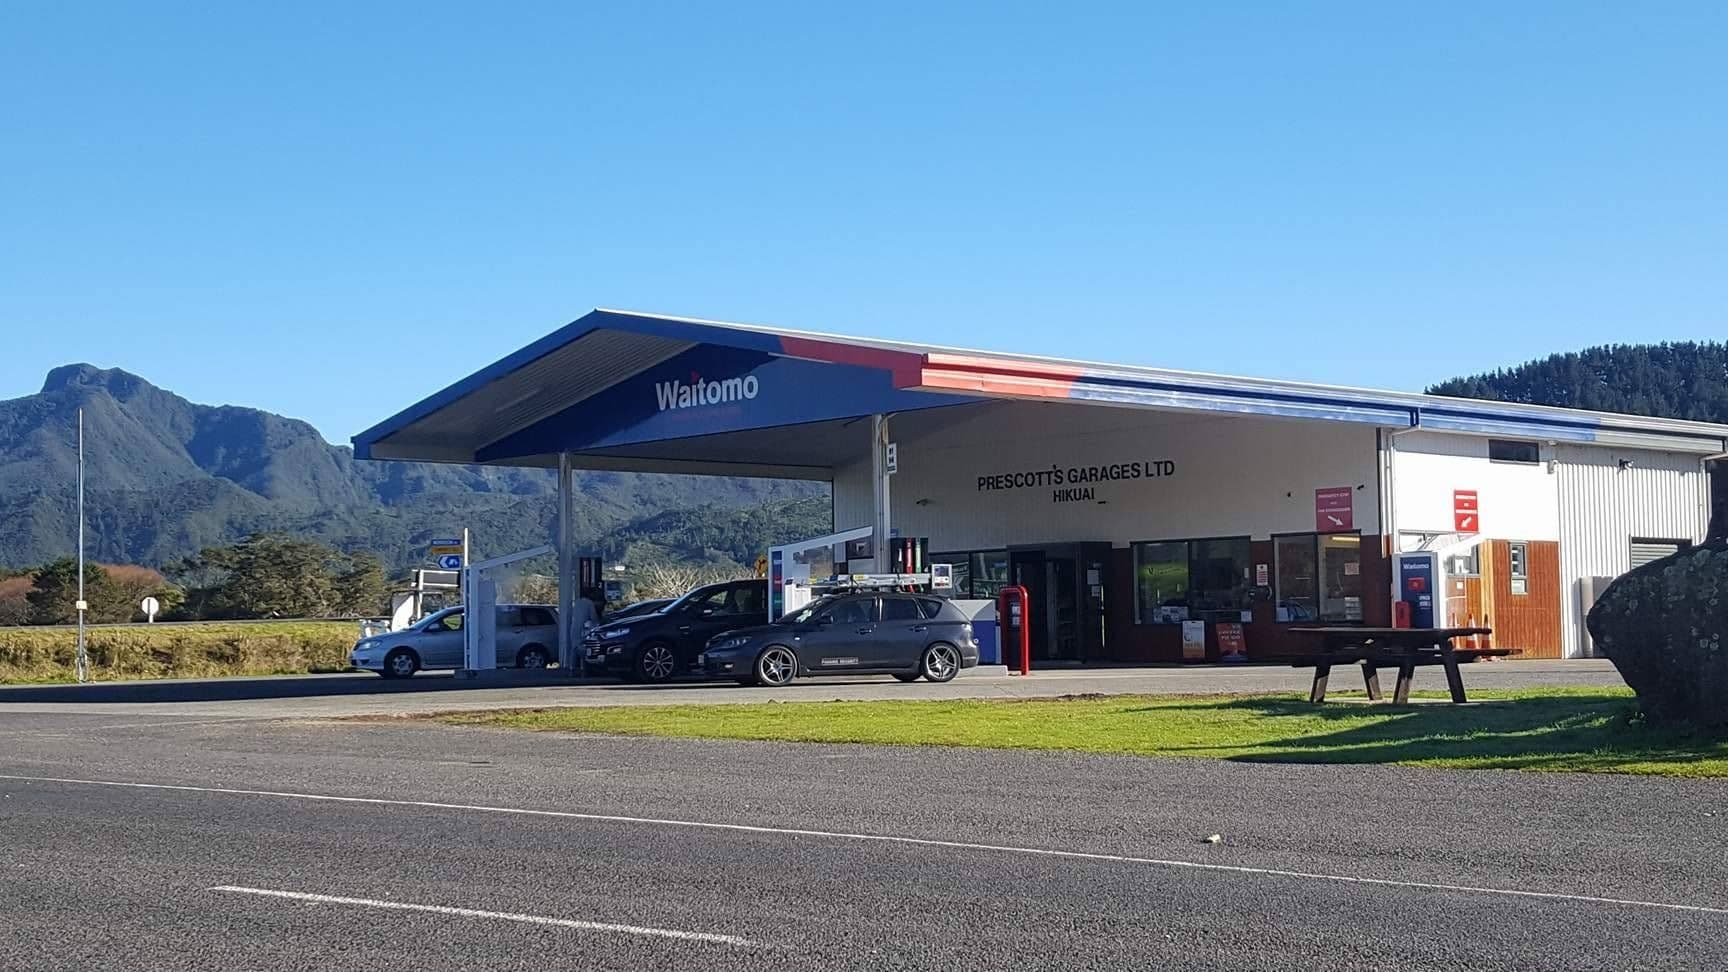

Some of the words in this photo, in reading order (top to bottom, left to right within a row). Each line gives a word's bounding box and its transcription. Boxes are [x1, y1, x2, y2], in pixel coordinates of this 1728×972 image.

[655, 372, 759, 411] Waitomo
[978, 464, 1064, 491] PRESCOTT'S
[1068, 462, 1141, 483] GARAGES
[1145, 460, 1175, 478] LTD
[1053, 487, 1095, 503] HIKUAI
